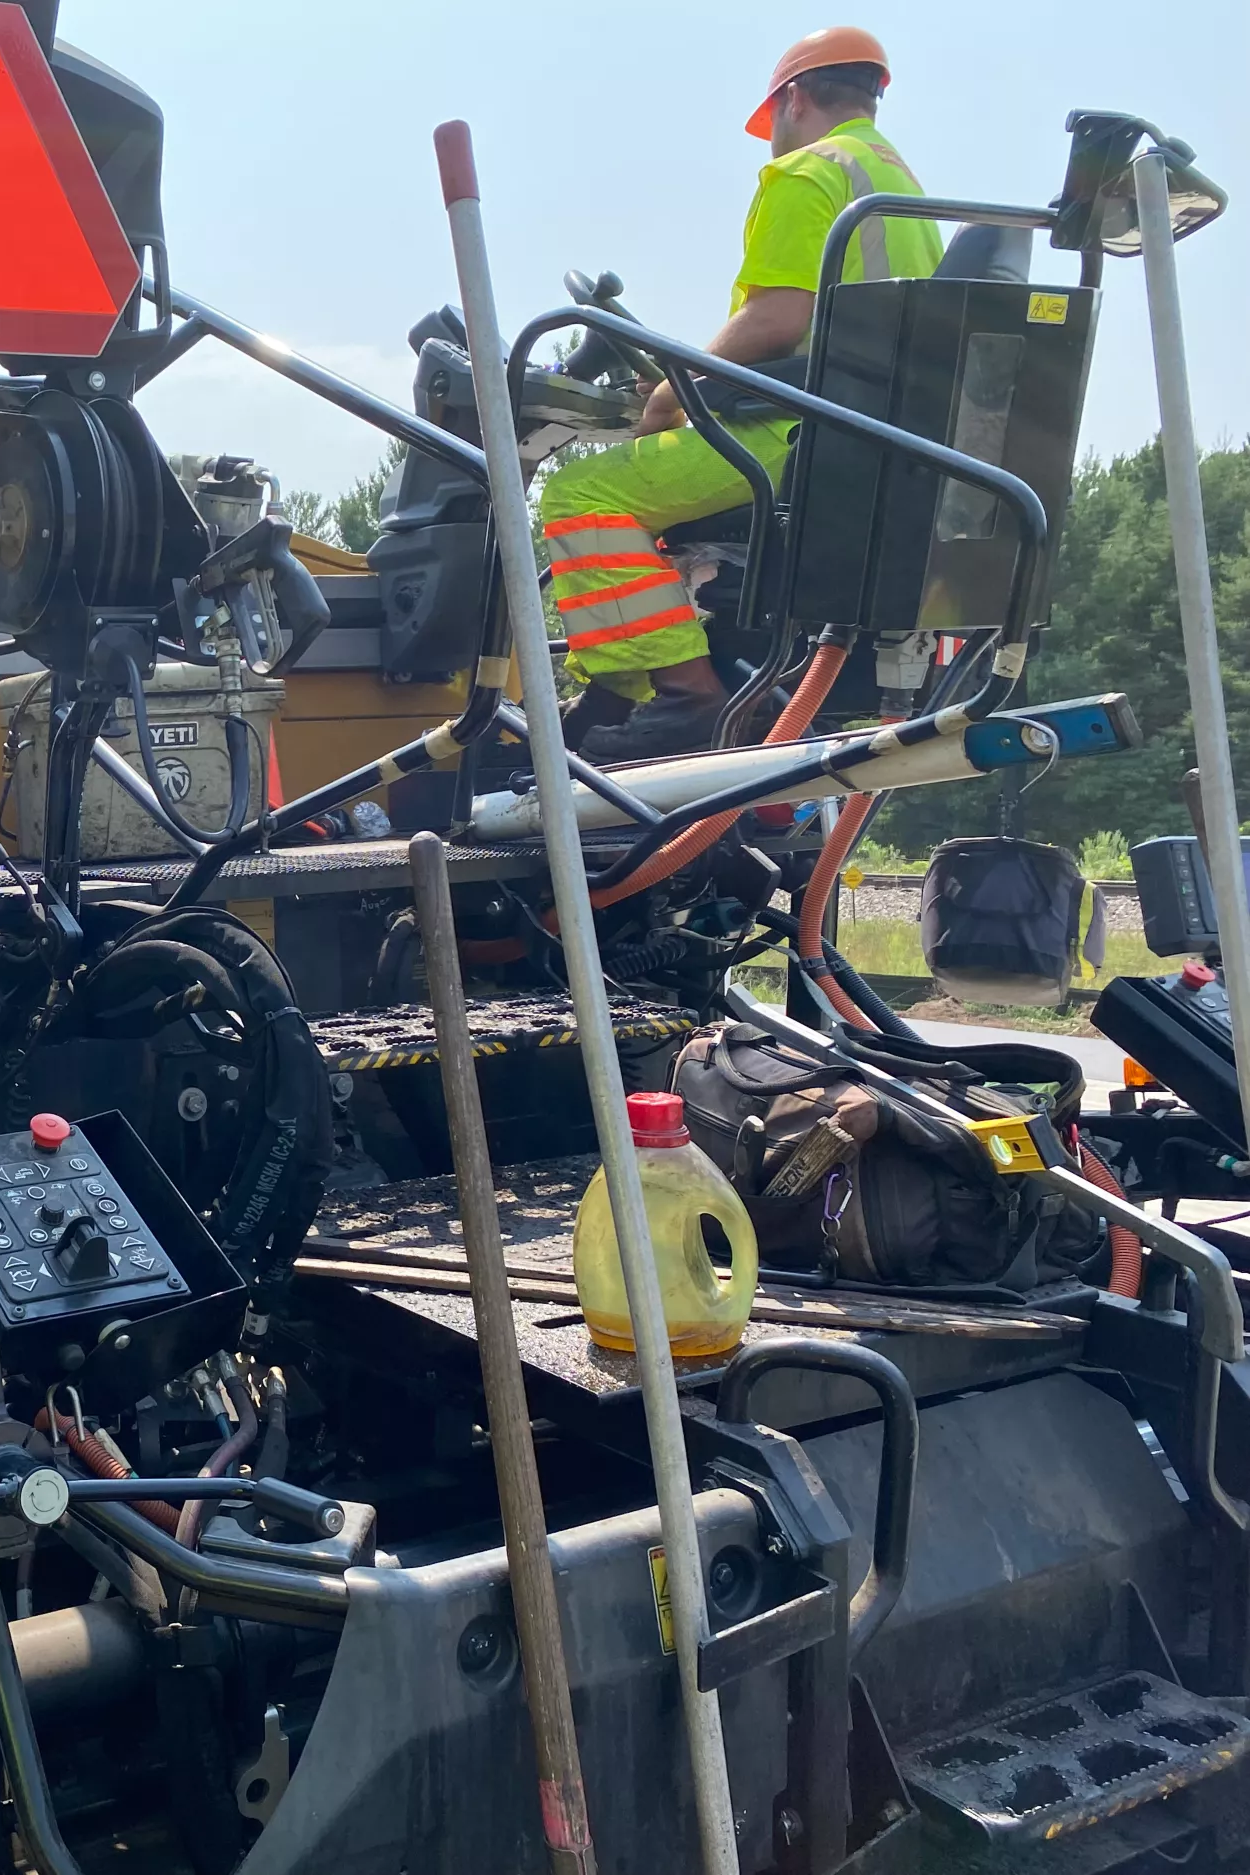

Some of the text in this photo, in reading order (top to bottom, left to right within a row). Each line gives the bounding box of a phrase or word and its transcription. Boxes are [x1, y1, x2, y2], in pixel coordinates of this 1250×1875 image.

[150, 727, 194, 743] YETI
[256, 1162, 284, 1193] MSHA
[769, 1157, 810, 1196] SON
